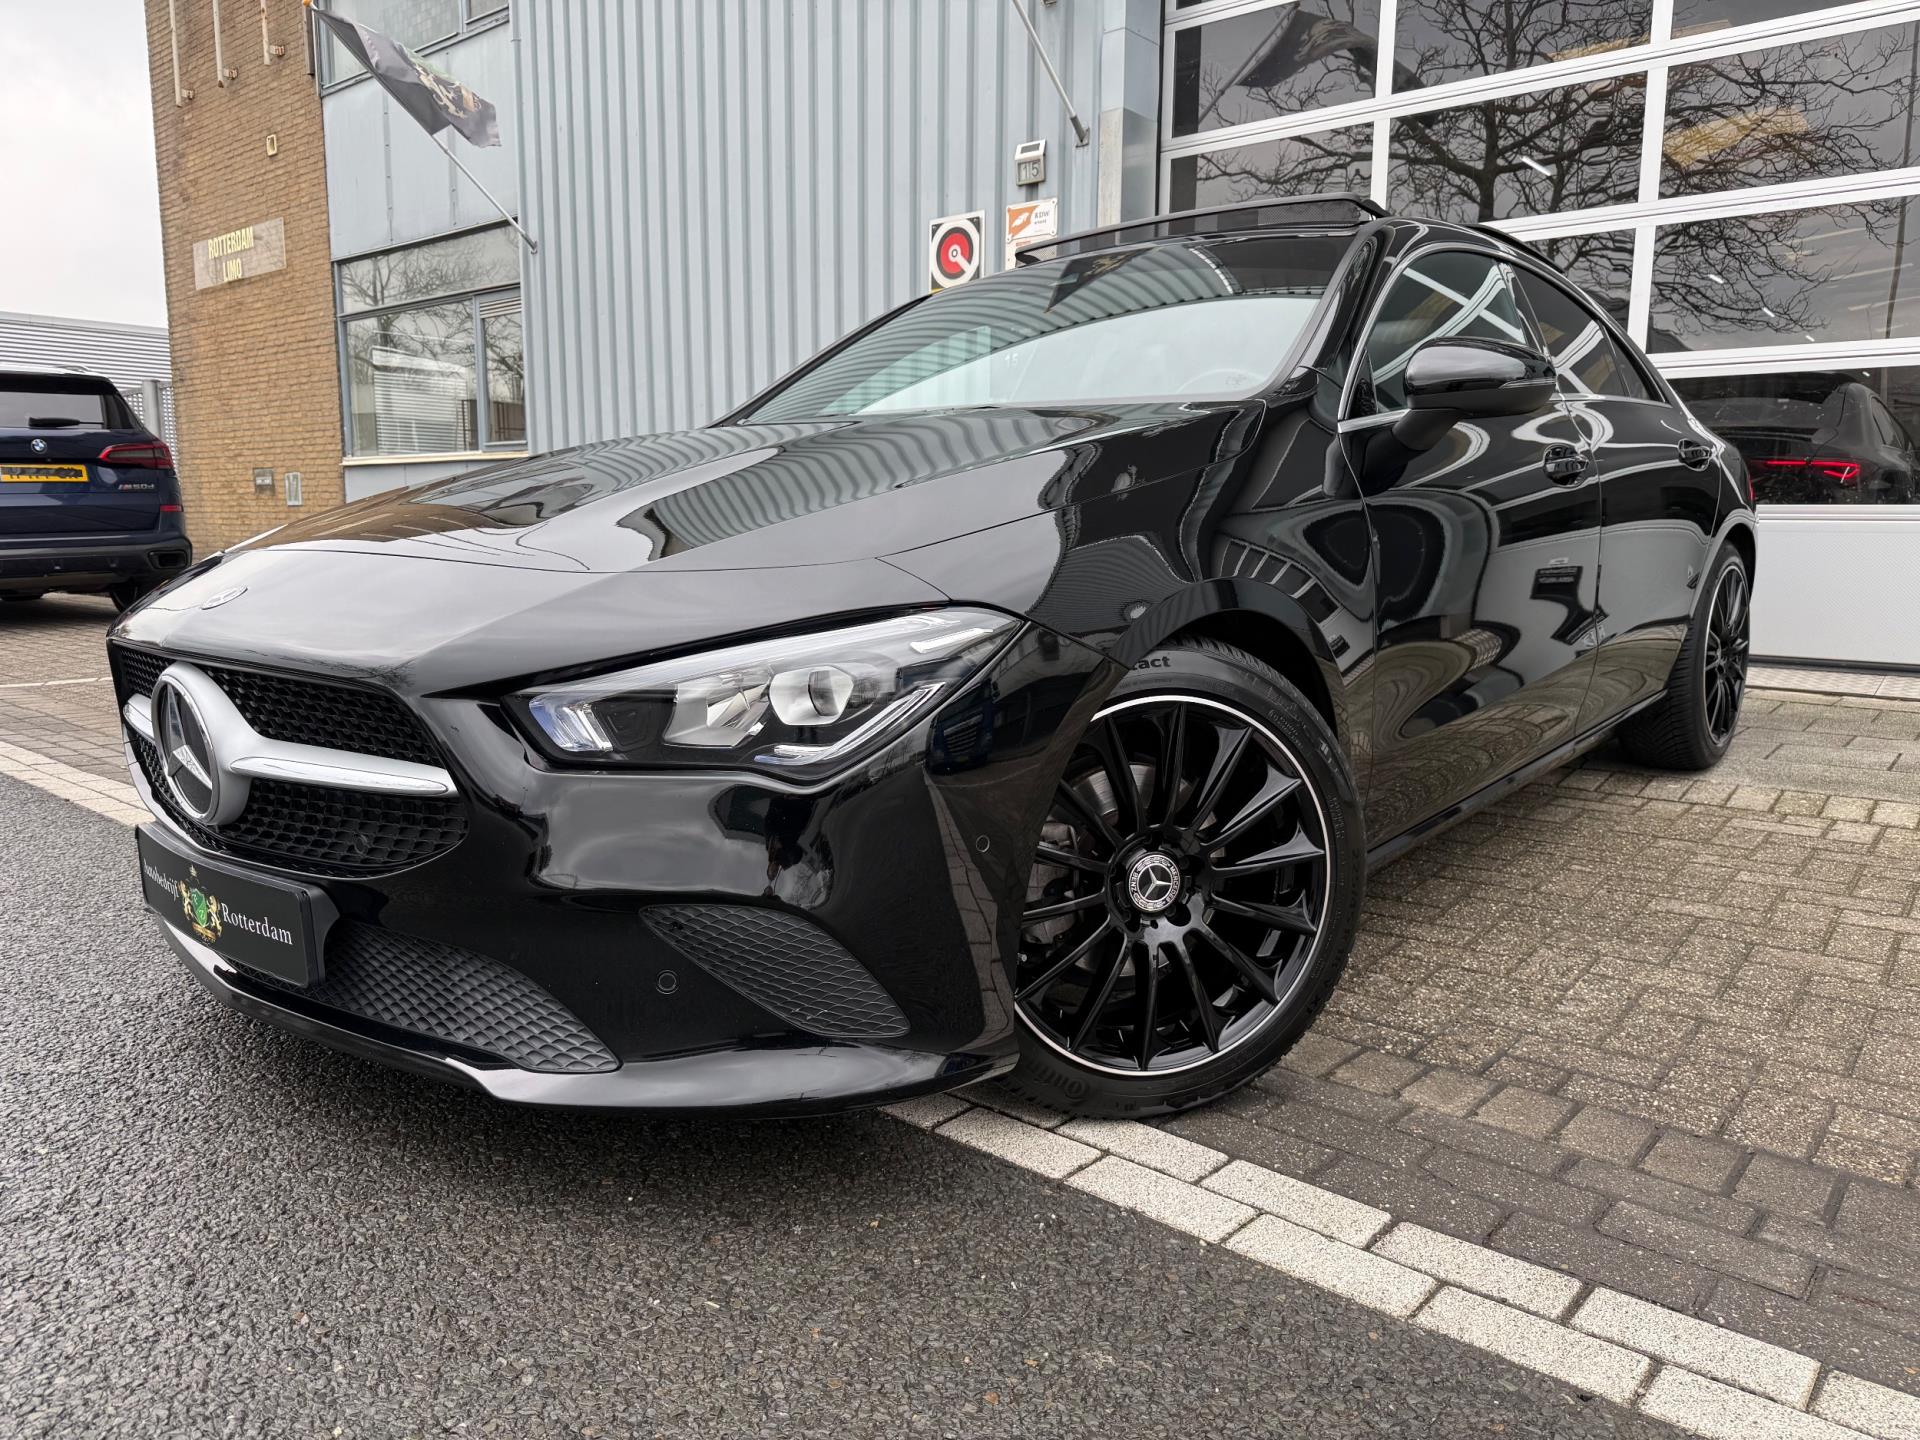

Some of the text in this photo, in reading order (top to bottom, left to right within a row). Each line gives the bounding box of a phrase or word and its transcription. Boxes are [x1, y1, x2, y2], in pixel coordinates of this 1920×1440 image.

[1023, 163, 1039, 178] 15
[208, 226, 254, 259] ROTTERDAM
[223, 258, 242, 282] LIMO
[221, 902, 293, 945] Rotterdam
